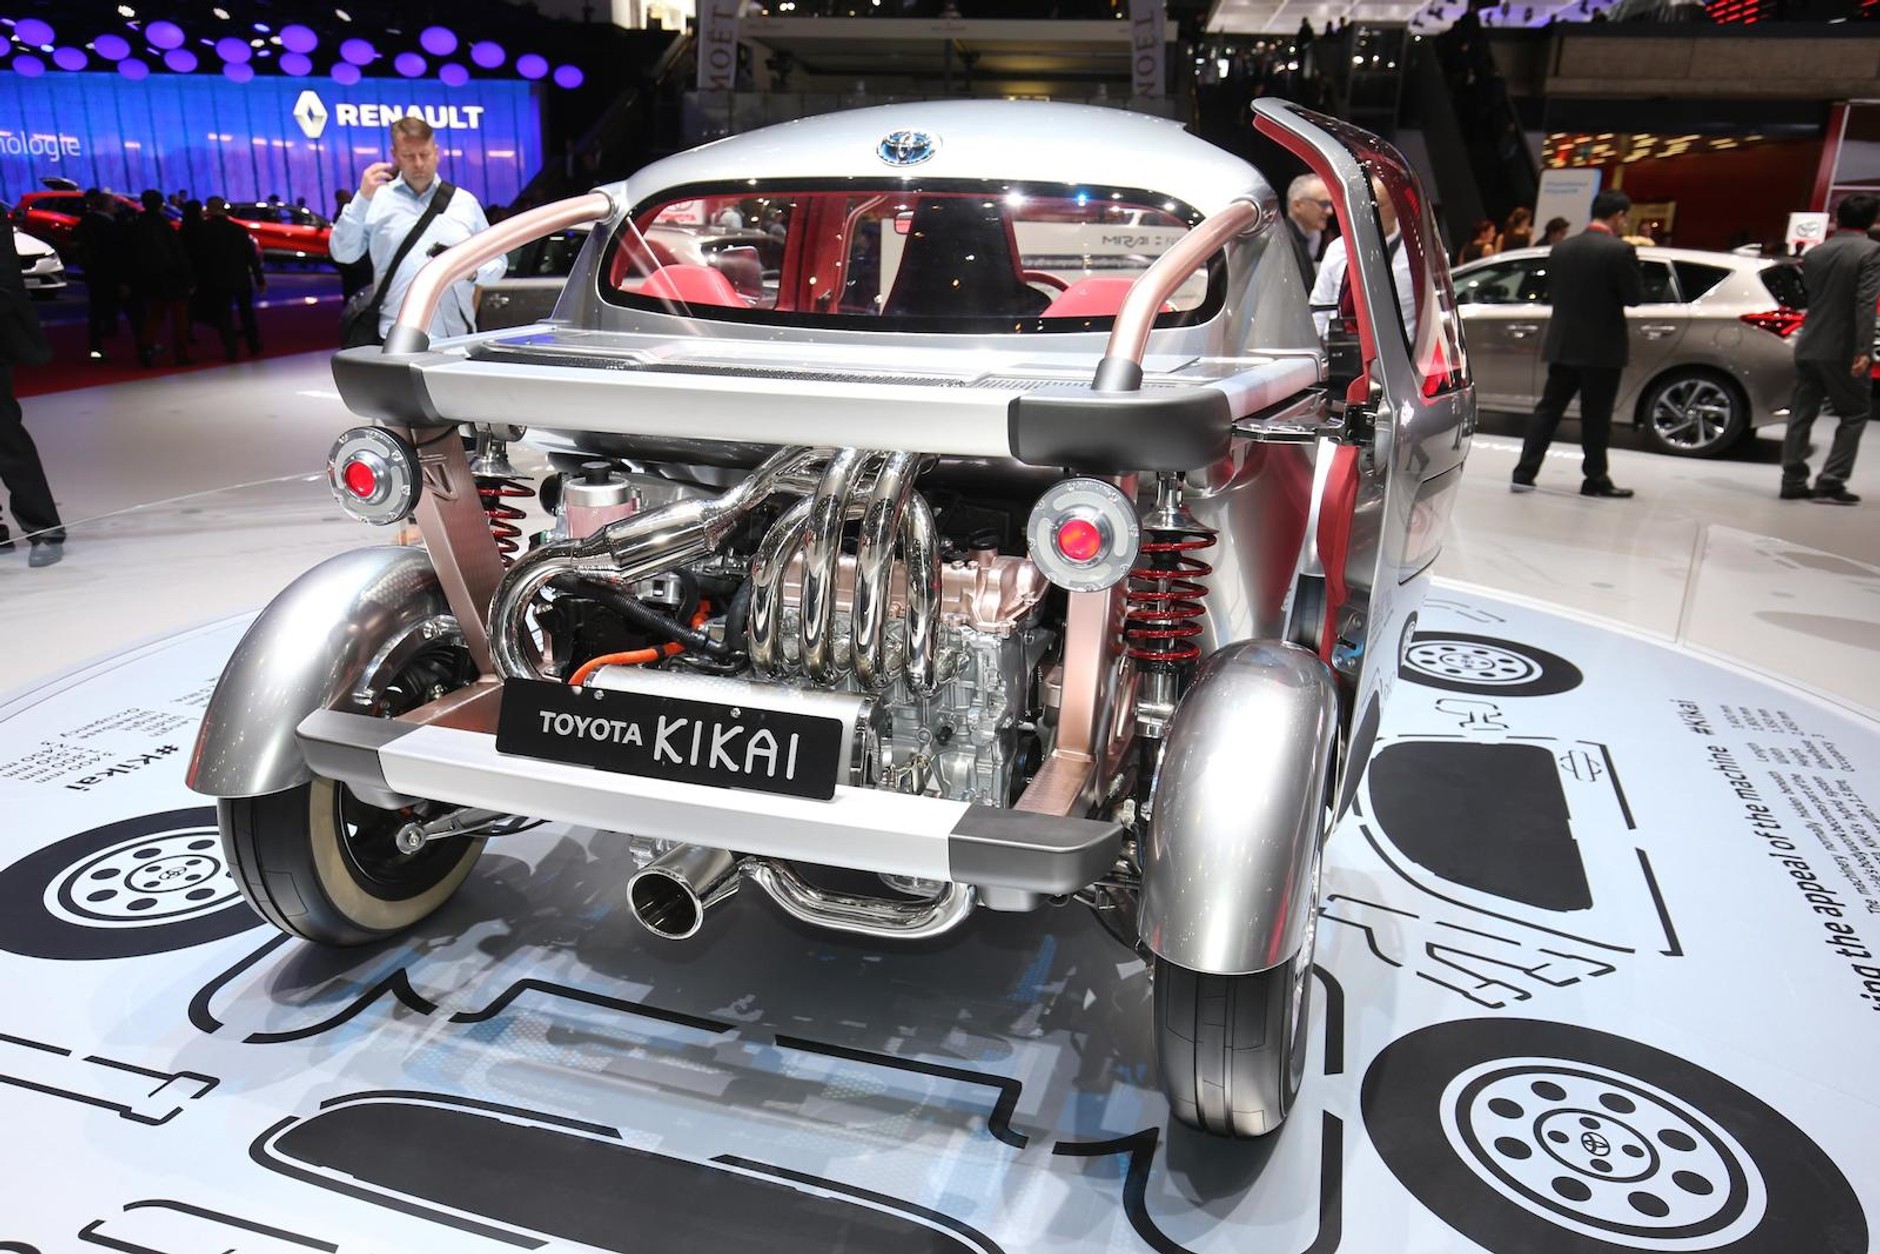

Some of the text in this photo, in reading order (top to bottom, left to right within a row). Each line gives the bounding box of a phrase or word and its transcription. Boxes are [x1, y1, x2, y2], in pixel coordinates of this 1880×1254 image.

[336, 104, 485, 129] RENAULT
[1670, 700, 1714, 735] #Kikai
[540, 710, 799, 780] TOYOTA KIKAI
[64, 743, 179, 792] #Kikai
[1707, 746, 1762, 801] machine
[1745, 804, 1781, 829] the
[1754, 830, 1795, 850] of
[1769, 853, 1846, 917] appeal
[1824, 922, 1872, 958] the
